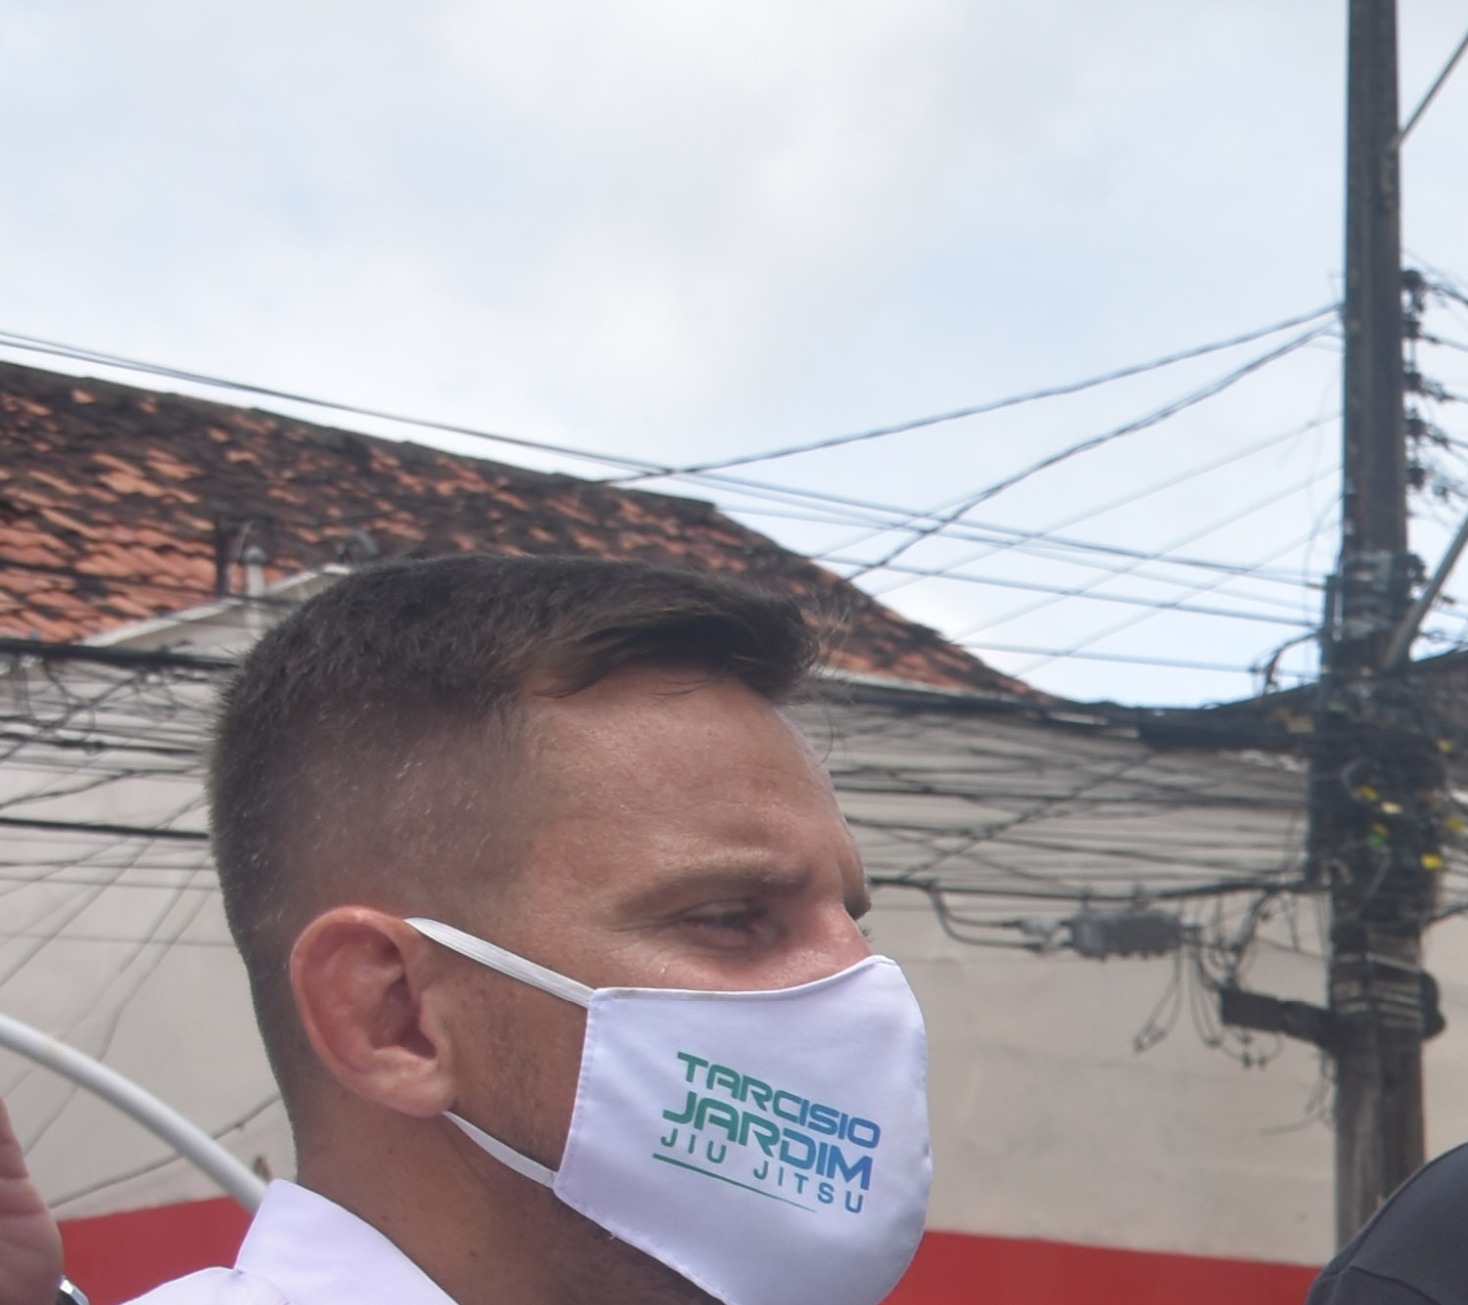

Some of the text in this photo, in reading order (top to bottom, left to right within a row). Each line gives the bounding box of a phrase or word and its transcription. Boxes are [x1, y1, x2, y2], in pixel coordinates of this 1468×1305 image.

[662, 1091, 873, 1191] JARDIM
[677, 1051, 881, 1149] TARCISIO
[660, 1128, 864, 1214] JIU JITSU
